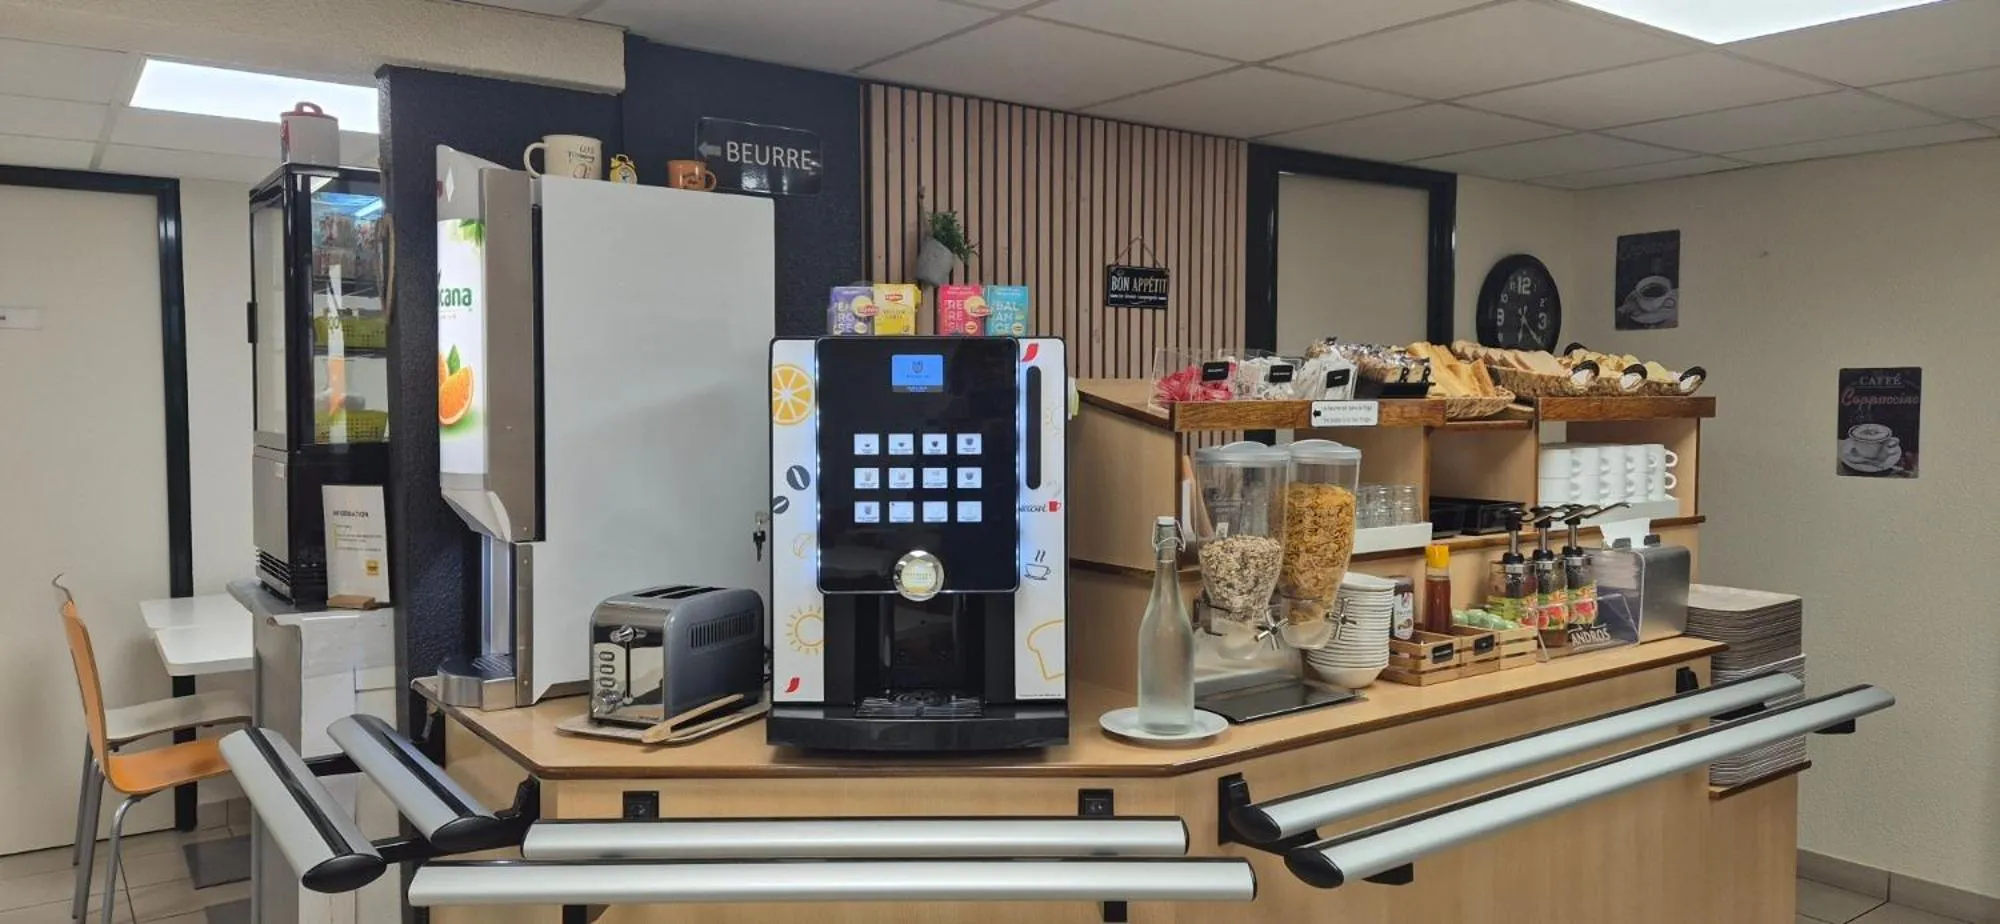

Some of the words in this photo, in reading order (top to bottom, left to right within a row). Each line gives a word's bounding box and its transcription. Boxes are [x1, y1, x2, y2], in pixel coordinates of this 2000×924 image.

[726, 141, 812, 170] BEURRE
[1111, 275, 1130, 292] BON
[1518, 276, 1531, 294] 12
[1538, 312, 1546, 329] 3
[1570, 627, 1611, 647] ANDROS
